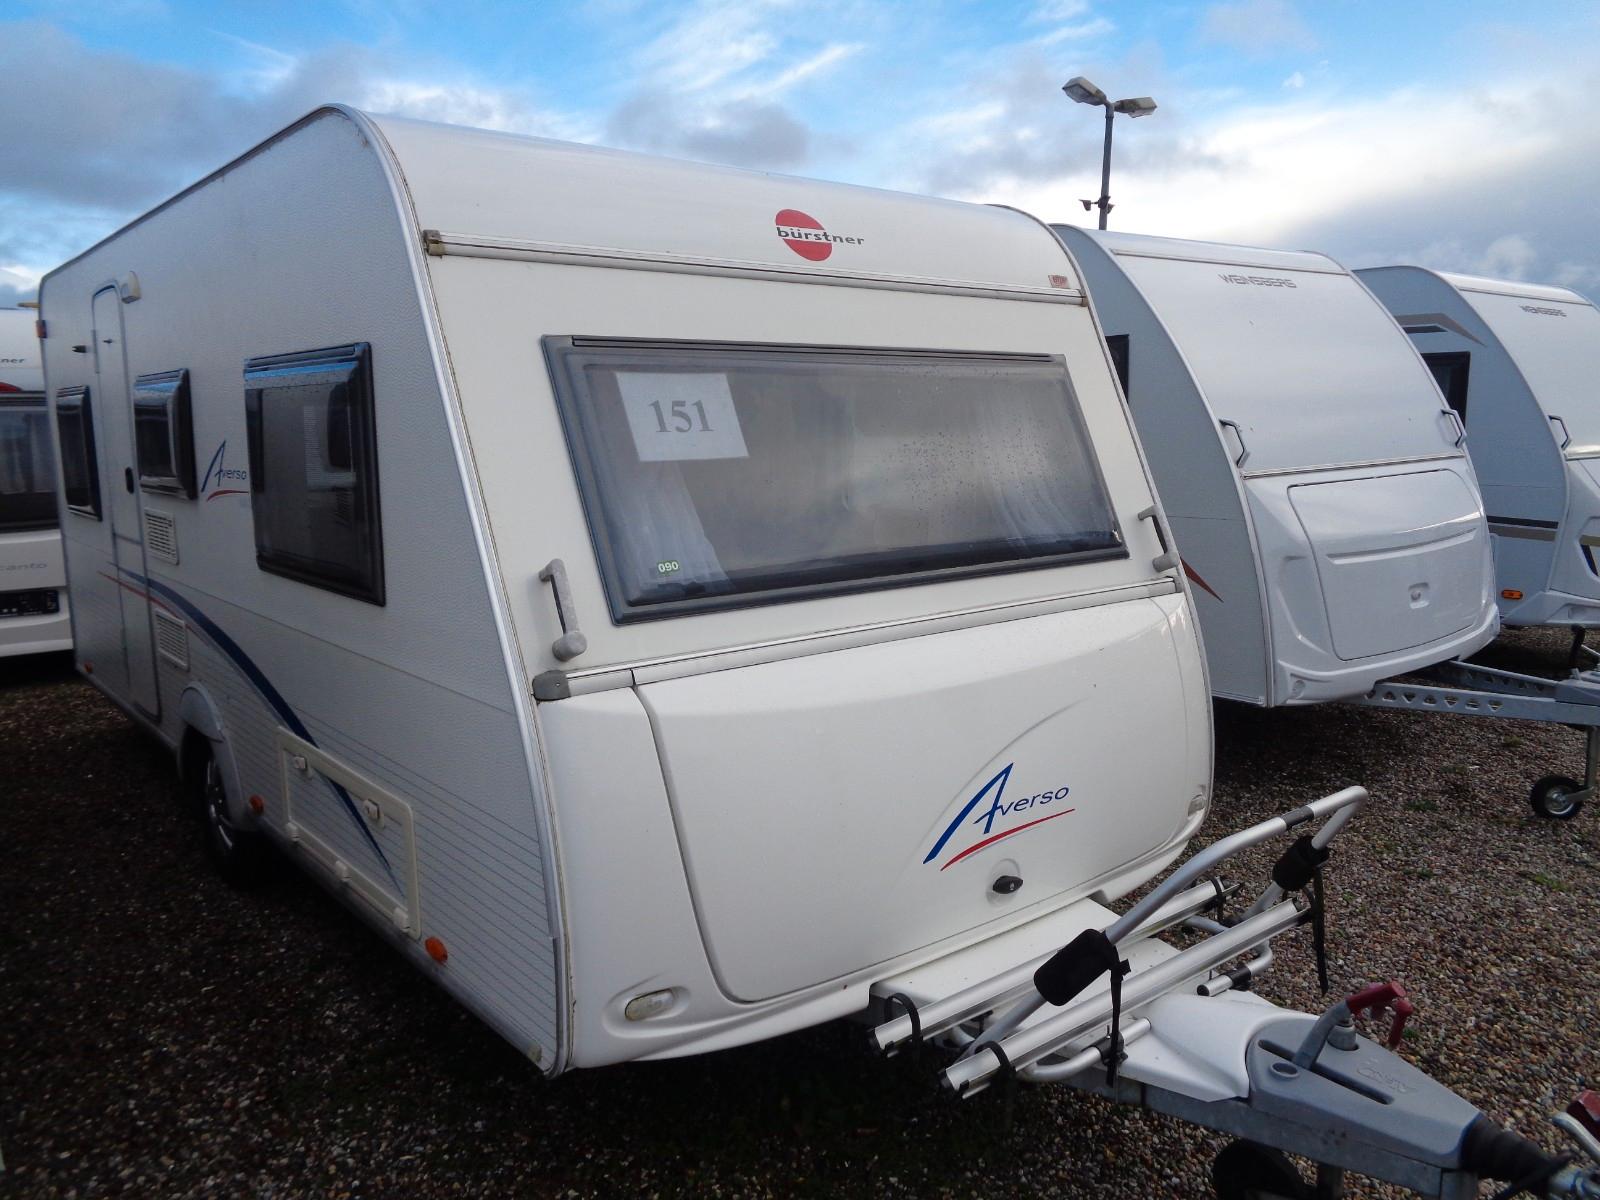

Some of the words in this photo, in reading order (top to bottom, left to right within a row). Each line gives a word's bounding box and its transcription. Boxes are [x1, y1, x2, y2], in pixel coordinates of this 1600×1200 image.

[776, 226, 865, 245] bürstner
[648, 399, 715, 433] 151
[200, 439, 248, 493] Averso
[657, 561, 680, 574] 090
[922, 762, 1070, 865] Averso
